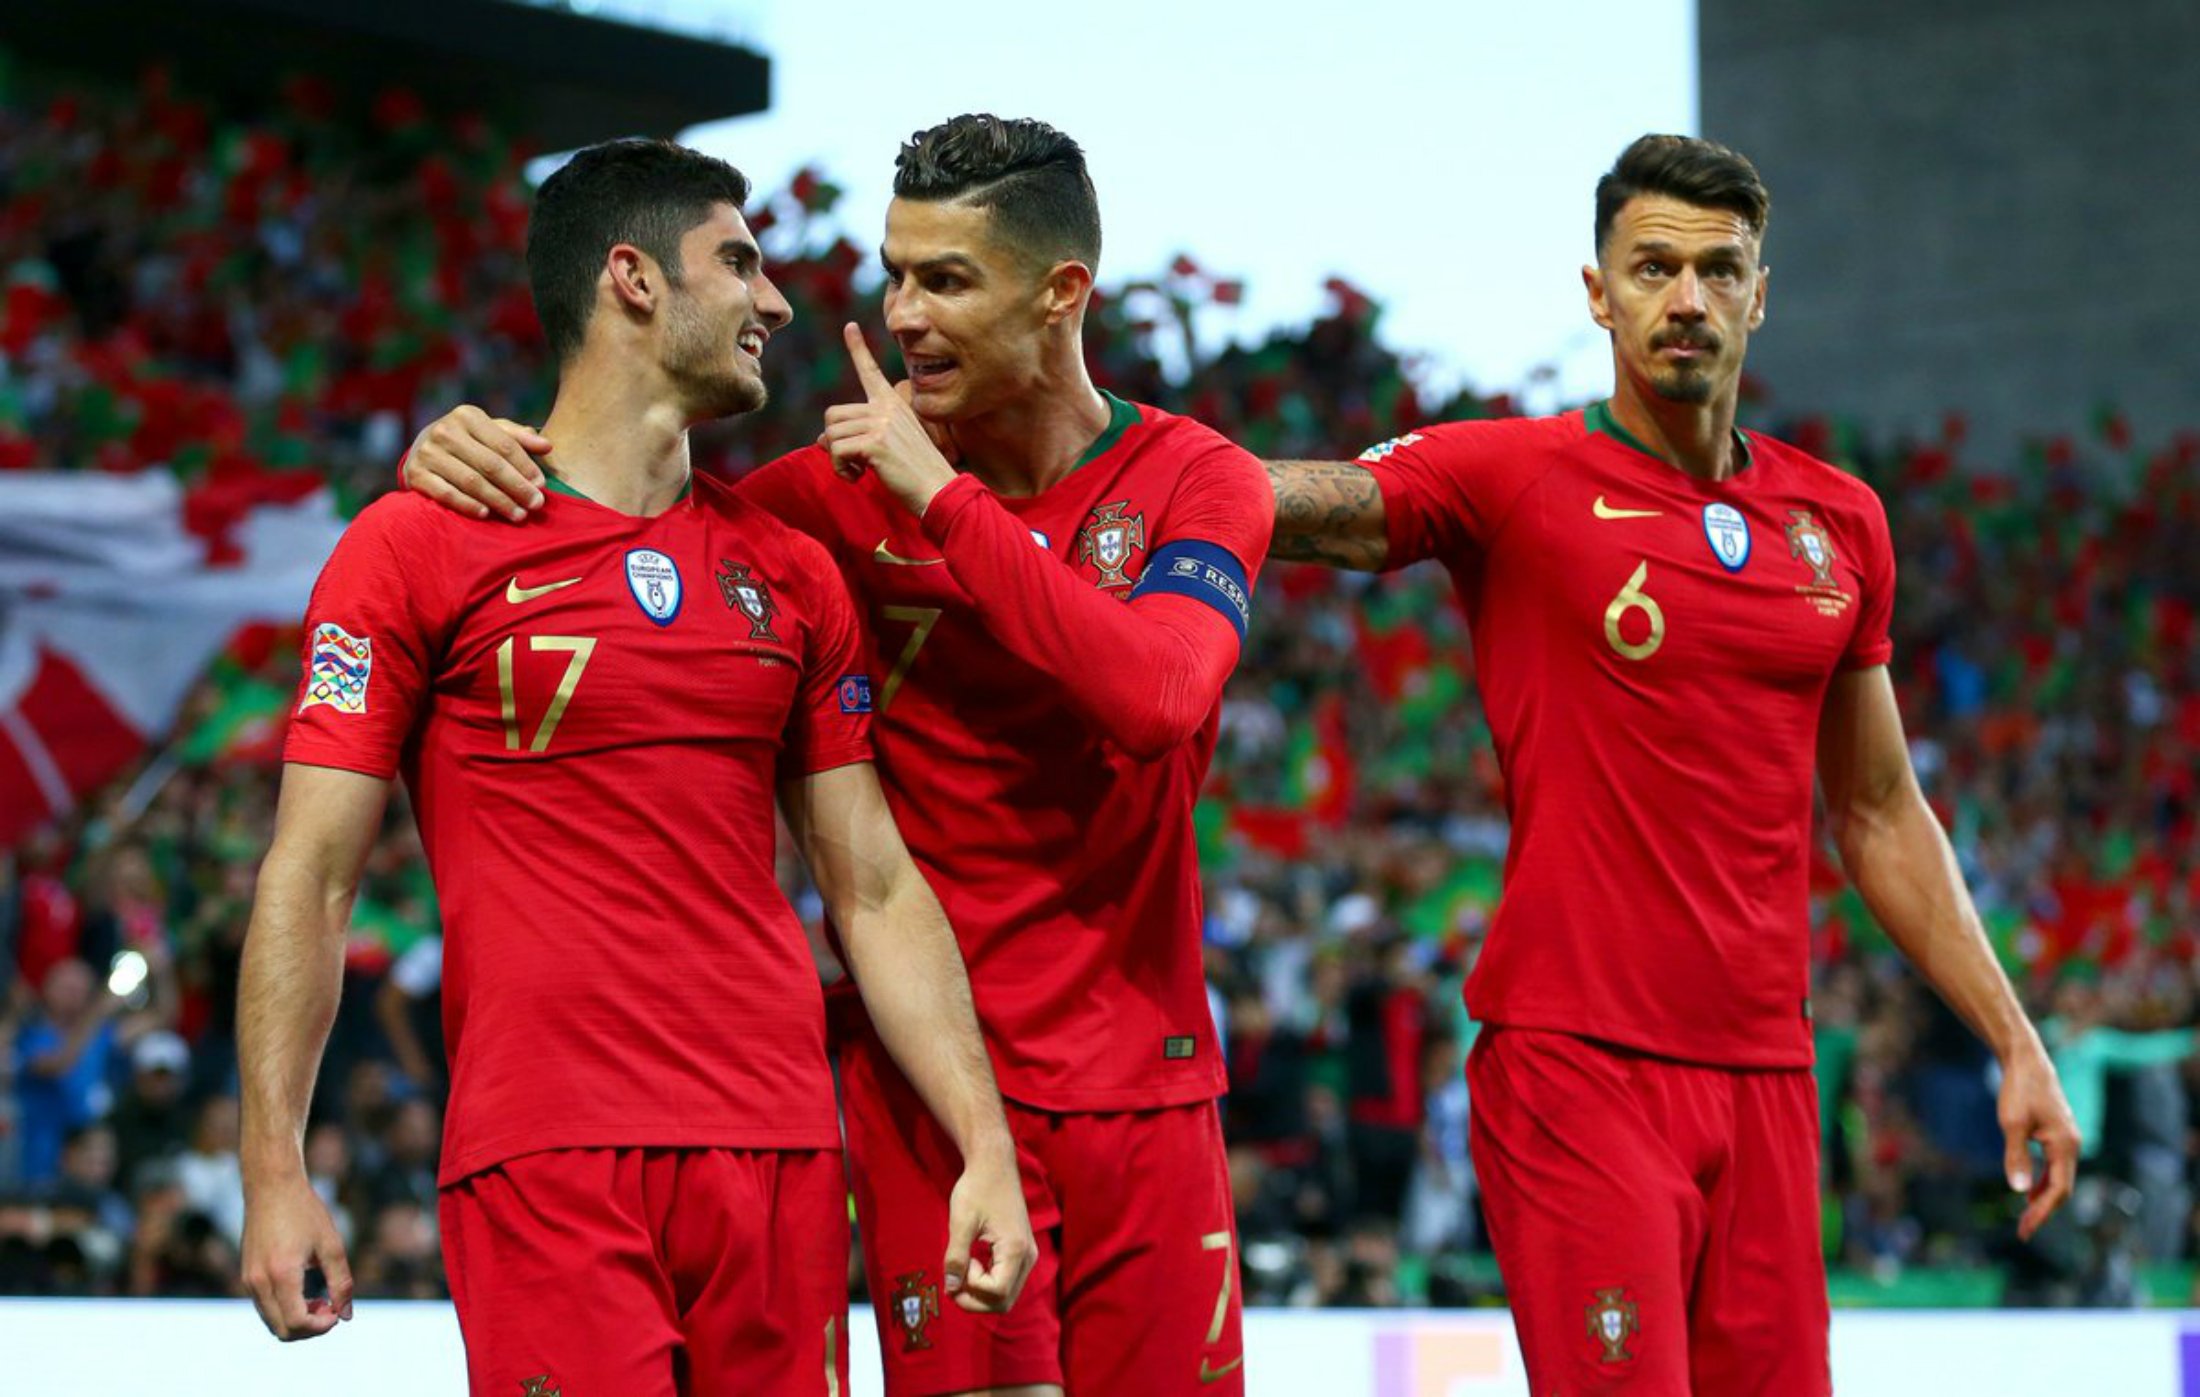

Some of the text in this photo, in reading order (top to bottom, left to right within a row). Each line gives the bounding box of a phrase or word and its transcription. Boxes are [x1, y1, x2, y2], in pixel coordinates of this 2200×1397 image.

[631, 564, 672, 573] EUROPEAN
[632, 571, 674, 581] CHAMPIONS
[1603, 559, 1666, 661] 6
[496, 635, 598, 753] 17
[878, 605, 944, 714] 7
[1201, 1230, 1232, 1344] 7
